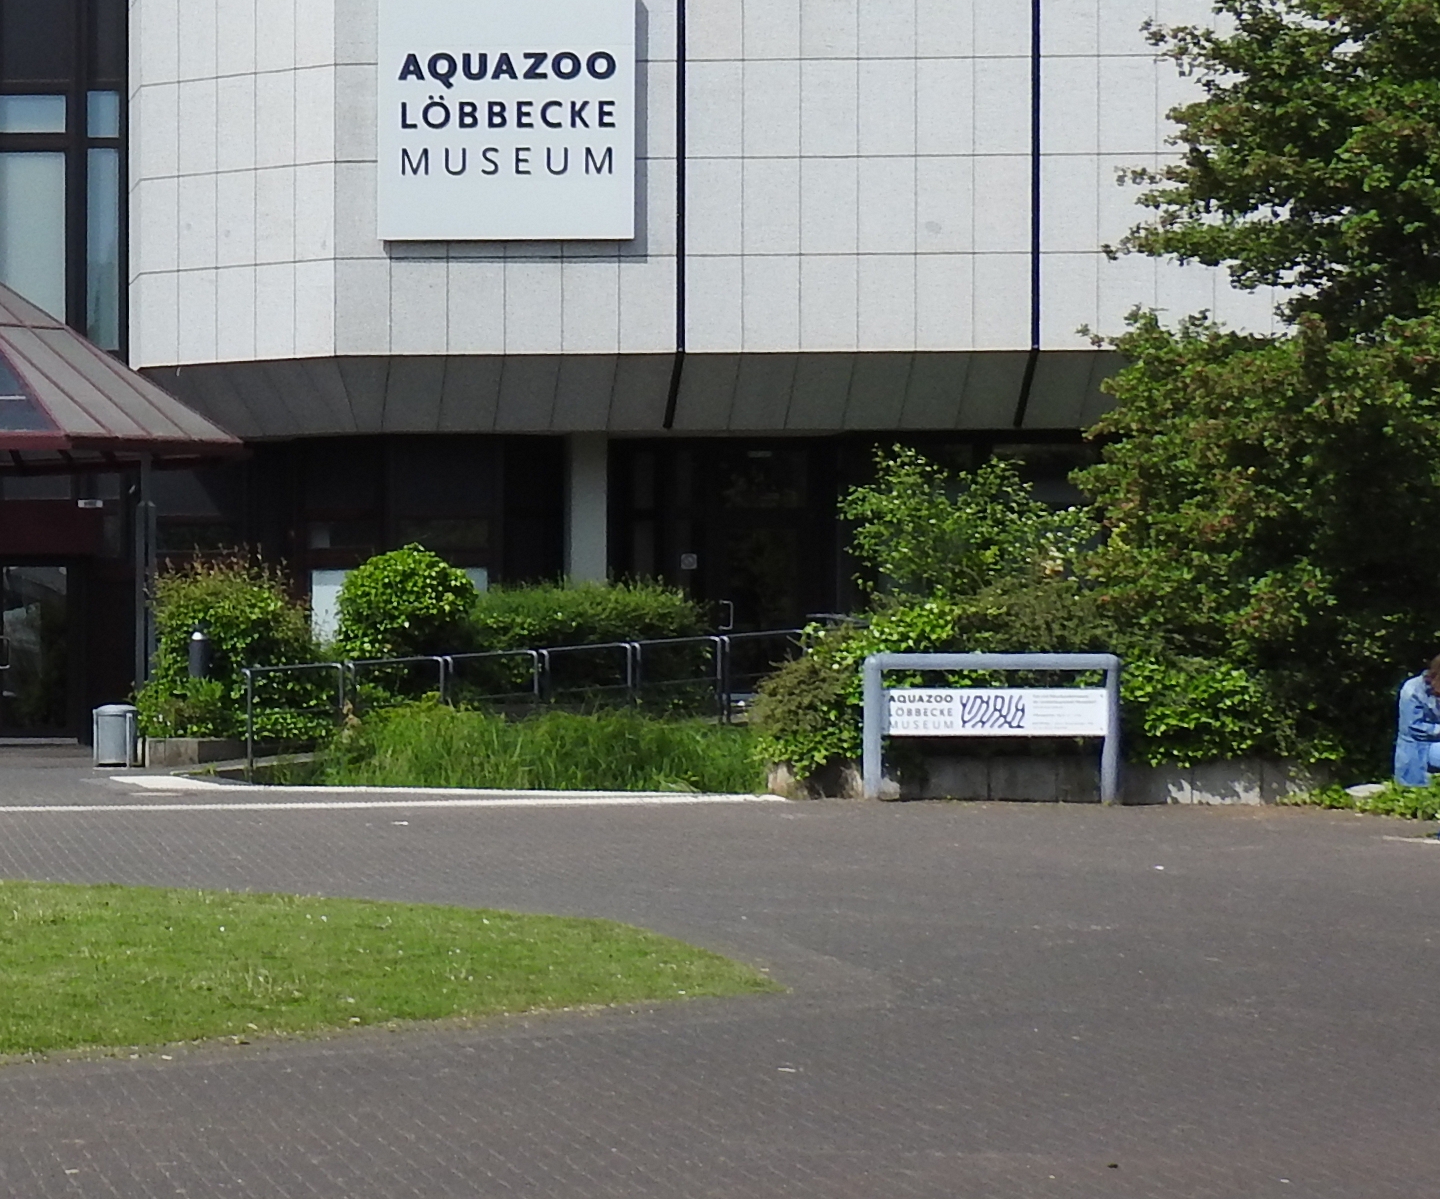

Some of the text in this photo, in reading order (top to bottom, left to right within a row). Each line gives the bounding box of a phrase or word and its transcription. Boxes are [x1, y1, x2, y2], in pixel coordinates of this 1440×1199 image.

[398, 51, 617, 89] AQUAZOO
[400, 94, 617, 129] LÖBBECKE
[400, 146, 614, 176] MUSEUM
[888, 694, 954, 704] AQUAZOO
[888, 706, 953, 717] LÖBBECKE
[888, 719, 954, 730] MUSEUM
